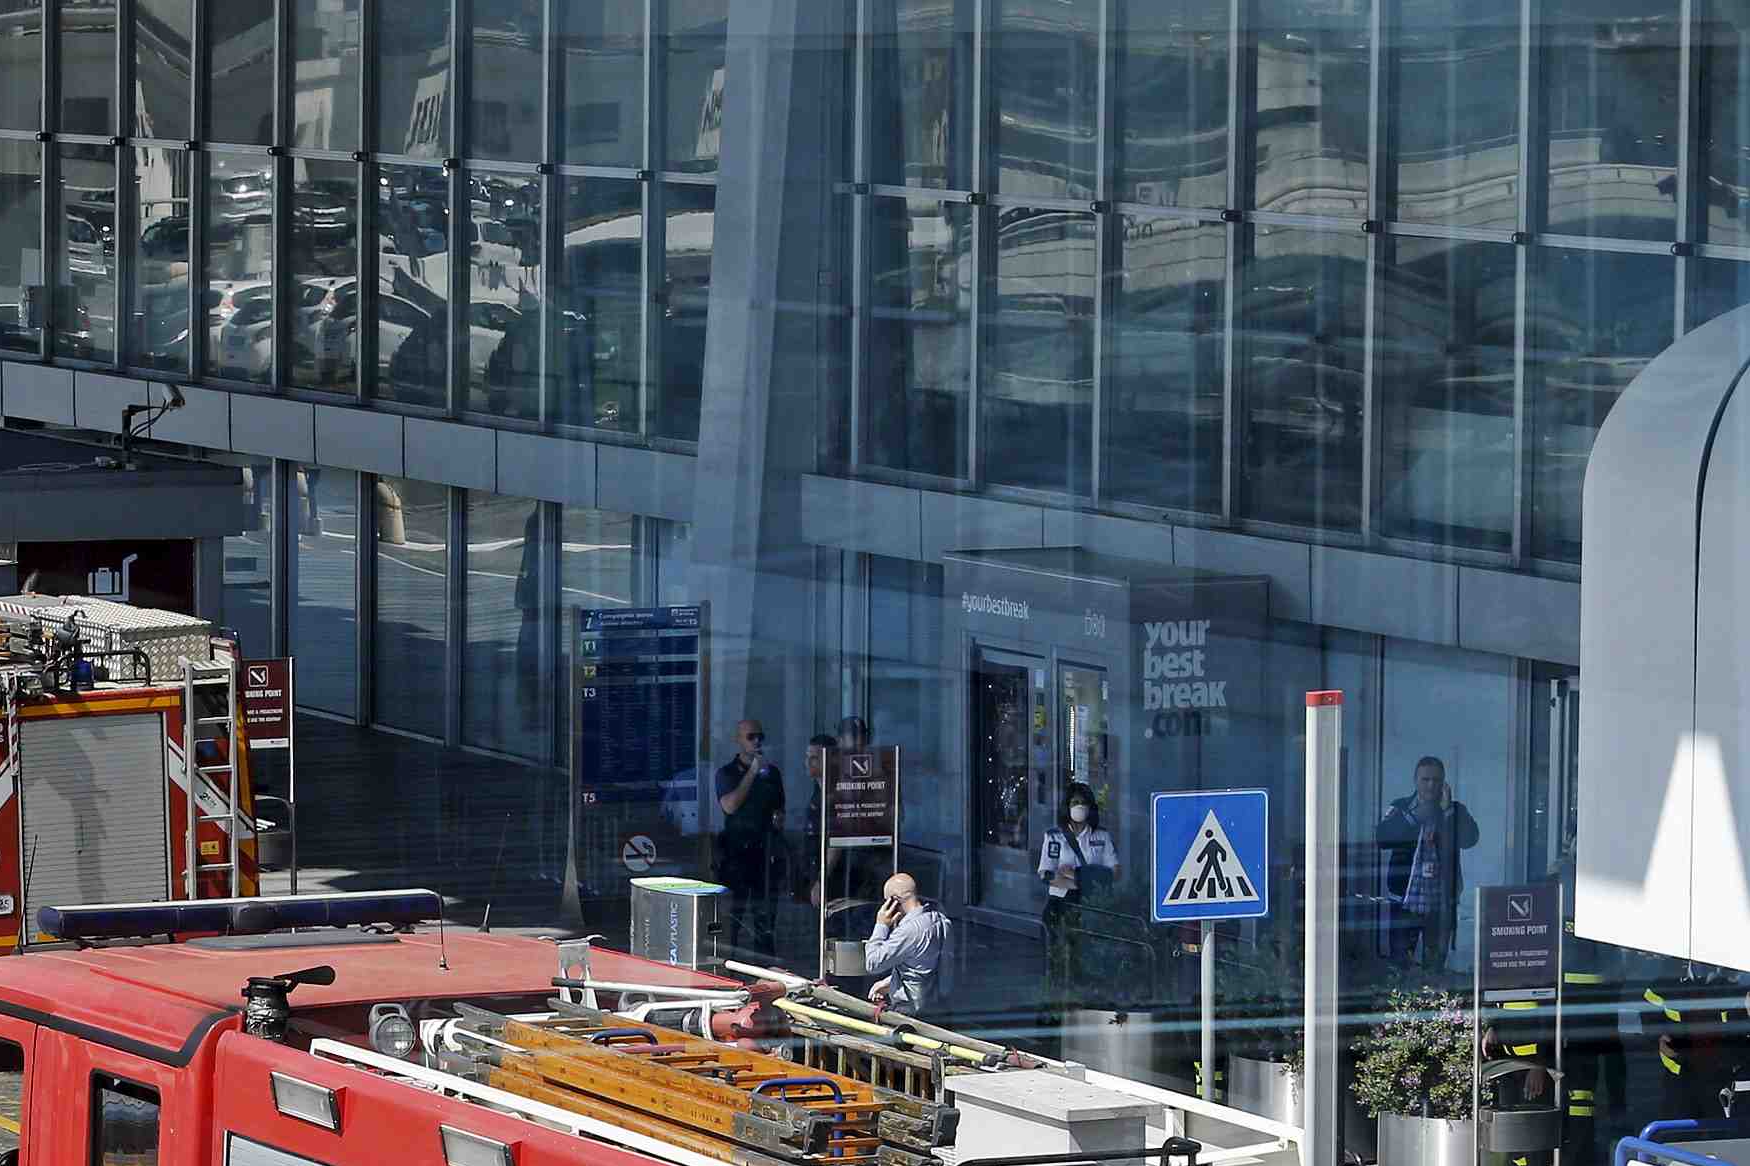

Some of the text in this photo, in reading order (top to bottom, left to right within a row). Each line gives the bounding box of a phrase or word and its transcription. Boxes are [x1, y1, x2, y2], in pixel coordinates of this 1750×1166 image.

[961, 591, 1030, 620] #yourbestbreak
[1143, 619, 1211, 649] your
[1143, 650, 1205, 680] best
[584, 687, 596, 697] T3
[1143, 680, 1227, 710] break
[1491, 925, 1547, 937] SMOKING POINT
